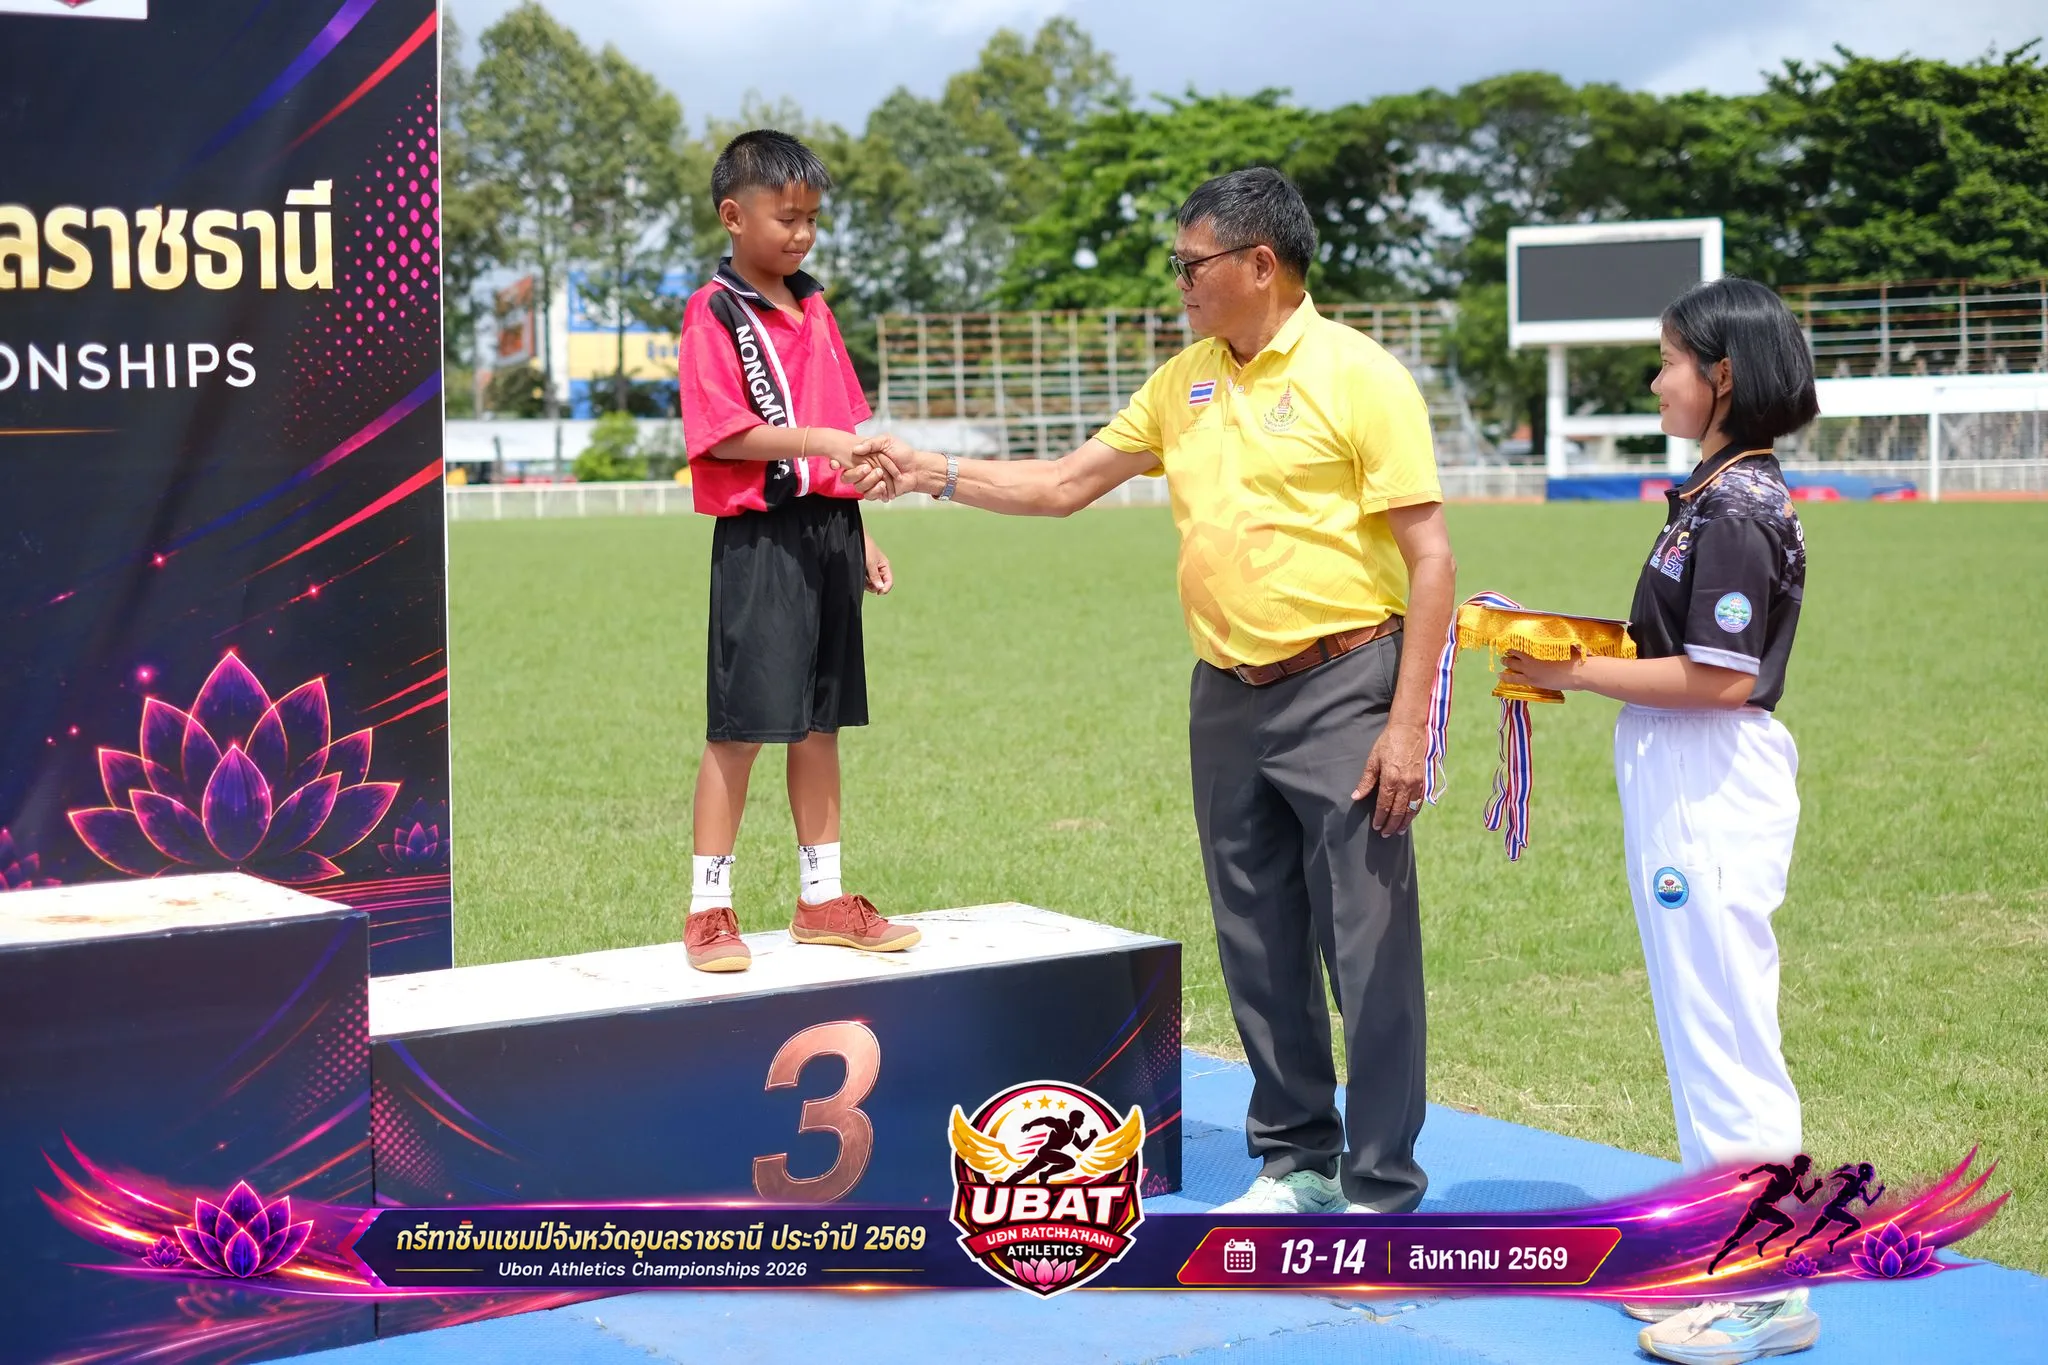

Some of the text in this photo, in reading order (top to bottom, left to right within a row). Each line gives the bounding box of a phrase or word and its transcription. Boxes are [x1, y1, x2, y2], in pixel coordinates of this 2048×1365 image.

[0, 178, 334, 290] ลราชธานี
[752, 1020, 881, 1208] 3
